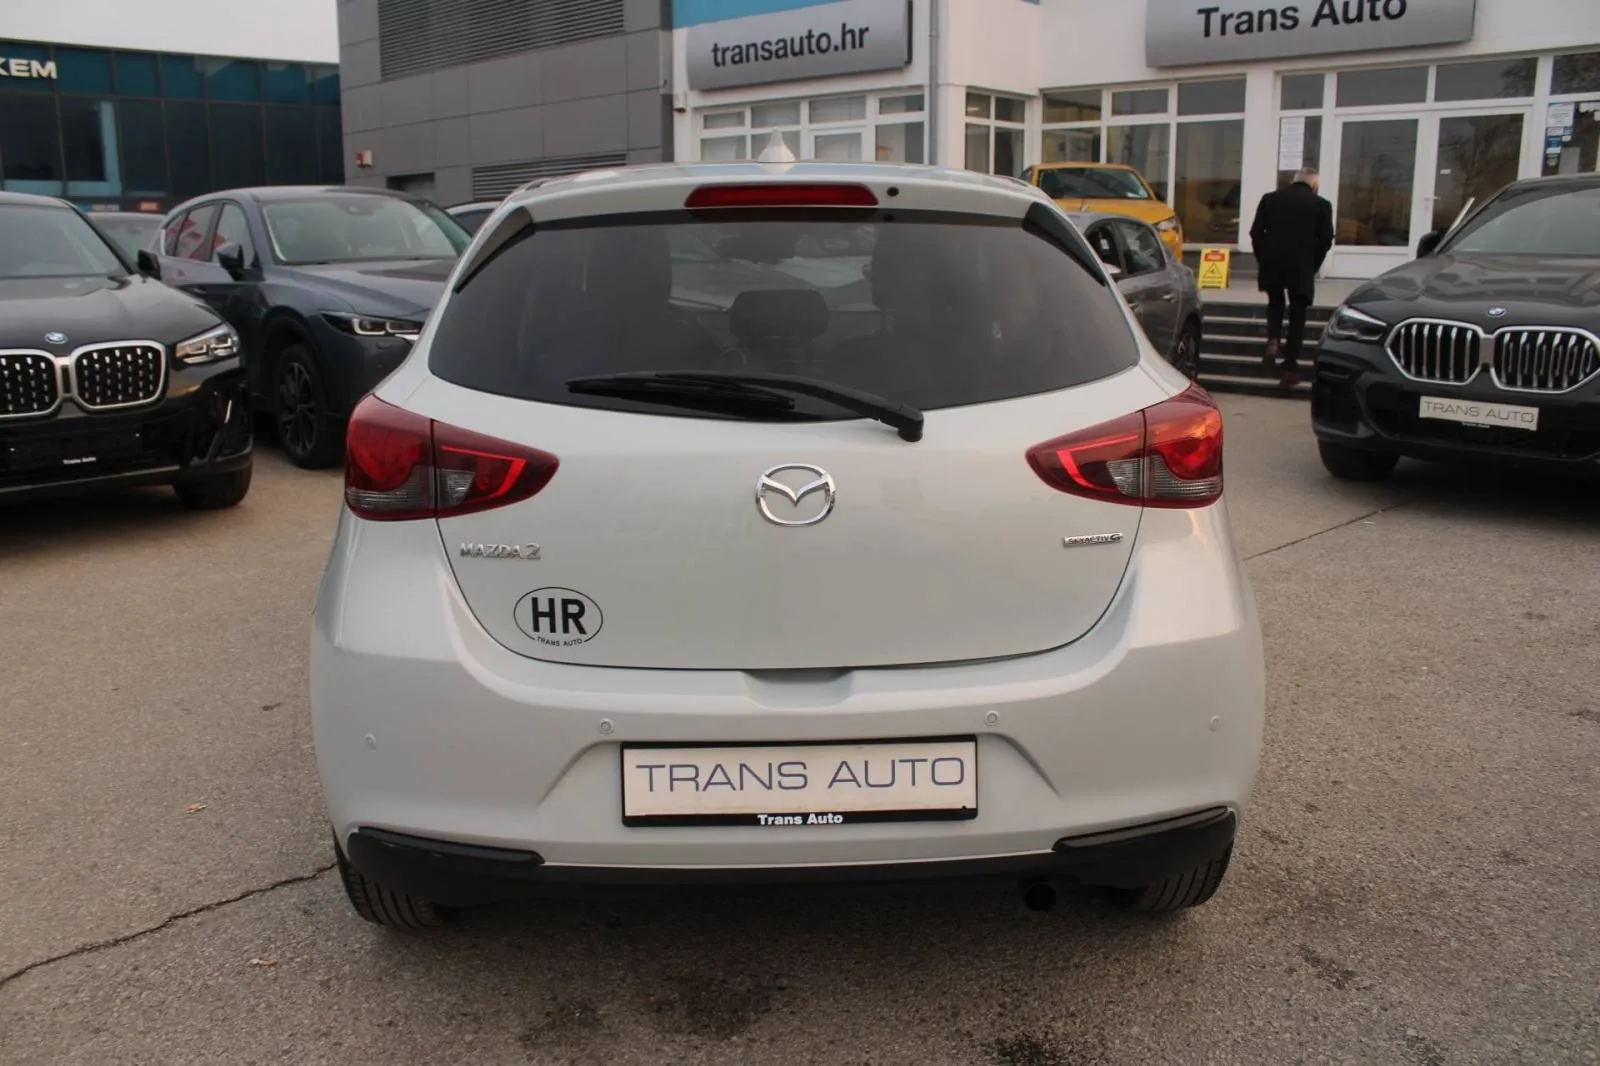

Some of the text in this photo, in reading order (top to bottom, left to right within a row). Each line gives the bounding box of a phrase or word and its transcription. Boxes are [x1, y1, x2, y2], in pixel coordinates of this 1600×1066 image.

[1197, 0, 1408, 38] Trans Auto
[711, 22, 870, 68] transauto.hr
[1423, 401, 1535, 424] TRANS AUTO
[531, 596, 587, 635] HR
[537, 636, 583, 647] TRANS AUTO
[636, 757, 965, 792] TRANS AUTO
[757, 813, 844, 826] Trans Auto
